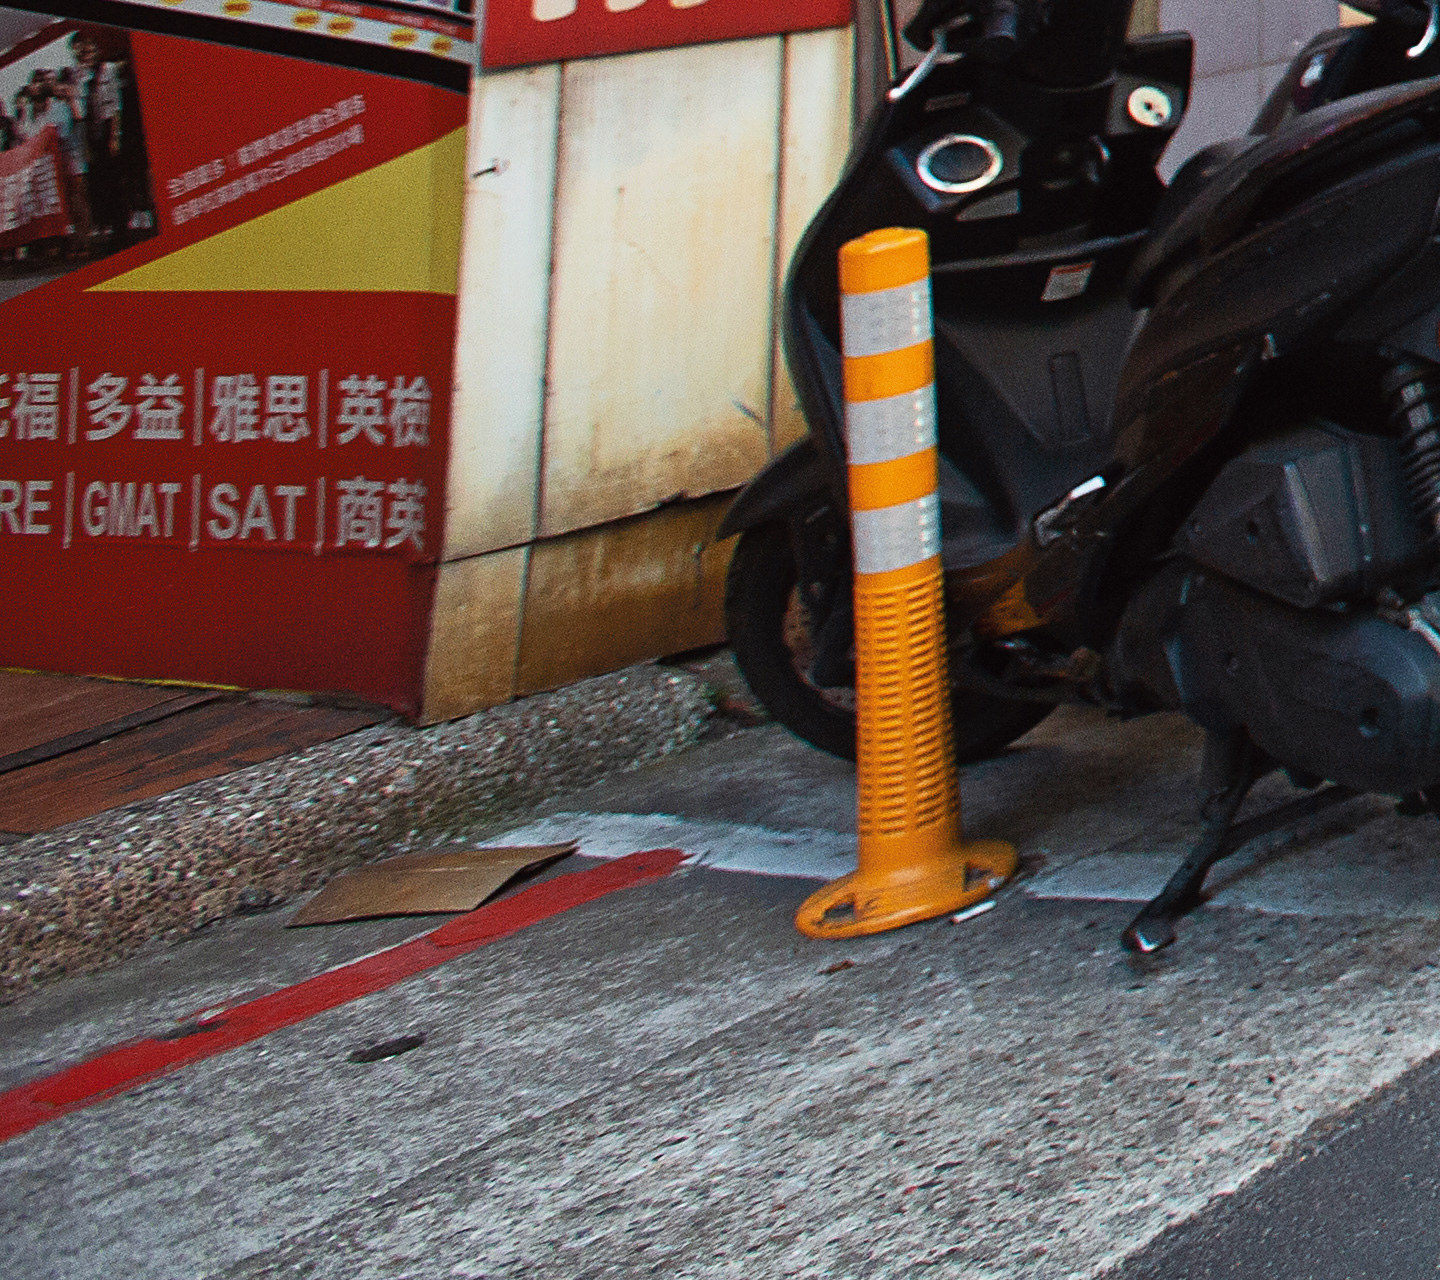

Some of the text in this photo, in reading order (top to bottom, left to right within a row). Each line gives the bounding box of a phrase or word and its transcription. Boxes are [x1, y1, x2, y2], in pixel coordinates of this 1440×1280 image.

[84, 371, 185, 442] 多益
[211, 372, 310, 444] 雅思
[337, 374, 431, 449] 英檢
[83, 481, 182, 542] GMAT
[209, 485, 307, 544] SAT
